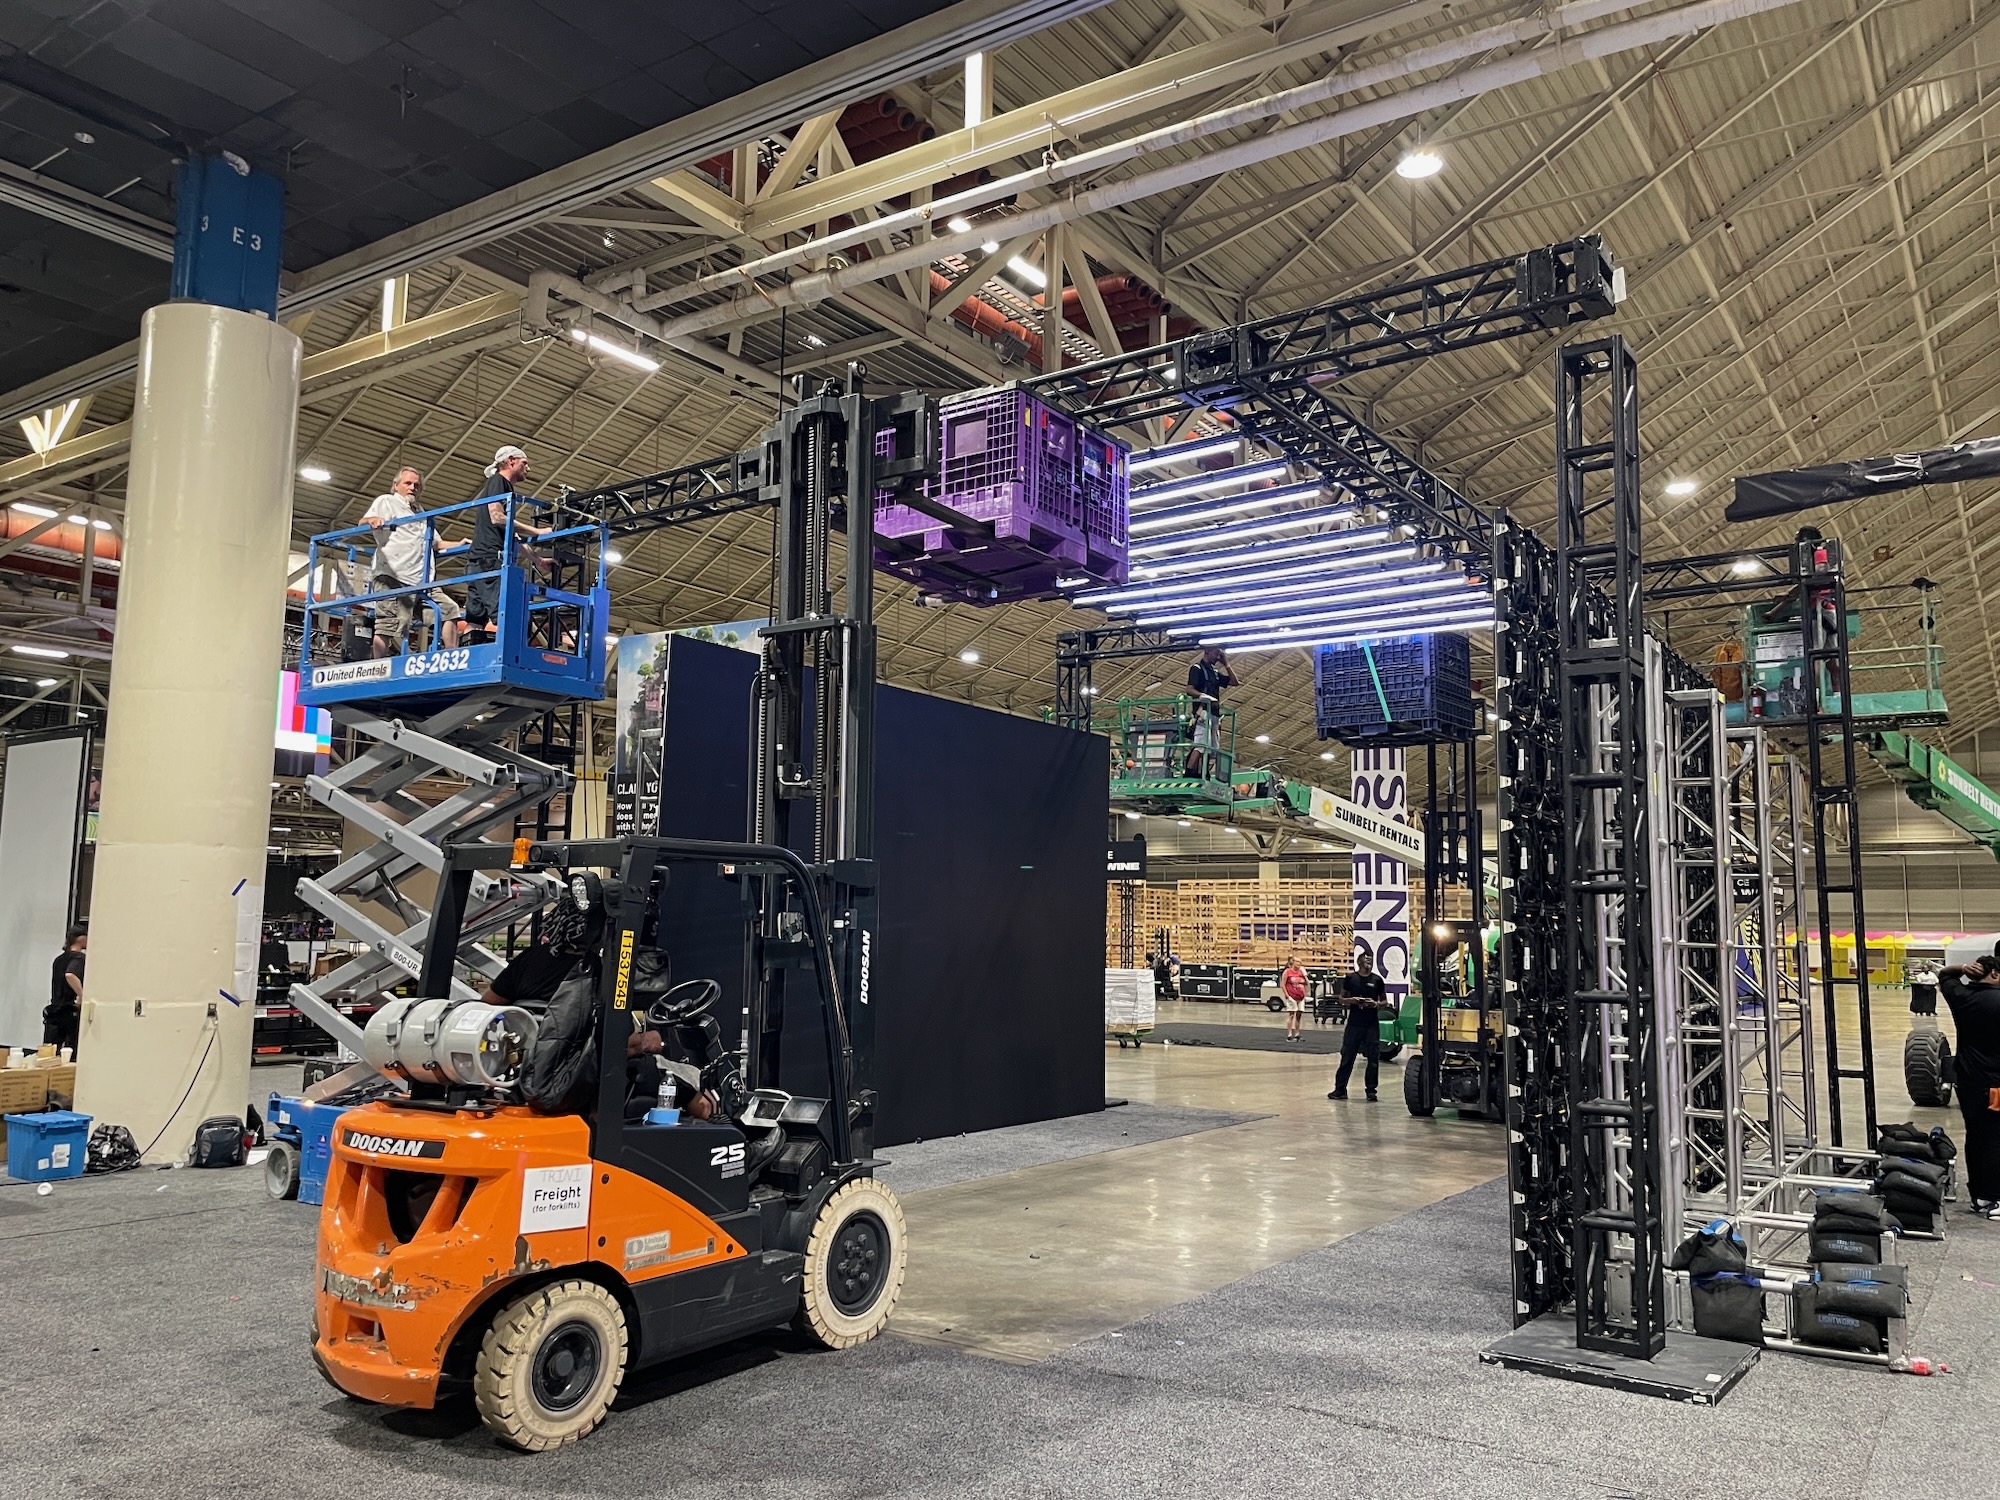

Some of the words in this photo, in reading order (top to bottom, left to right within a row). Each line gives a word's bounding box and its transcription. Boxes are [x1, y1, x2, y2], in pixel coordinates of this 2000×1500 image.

[327, 667, 354, 682] United
[356, 664, 387, 678] Rentals
[405, 649, 470, 676] GS-2632
[1334, 806, 1378, 834] SUNBELT
[1379, 824, 1420, 851] RENTALS
[393, 951, 421, 975] 800-UR-
[615, 932, 633, 1008] 11537545
[860, 929, 871, 1005] DOOSAN
[349, 1132, 425, 1157] DOOSAN
[711, 1142, 746, 1167] 25
[534, 1186, 581, 1202] Freight
[532, 1204, 547, 1213] (for
[549, 1201, 581, 1211] forklifts)
